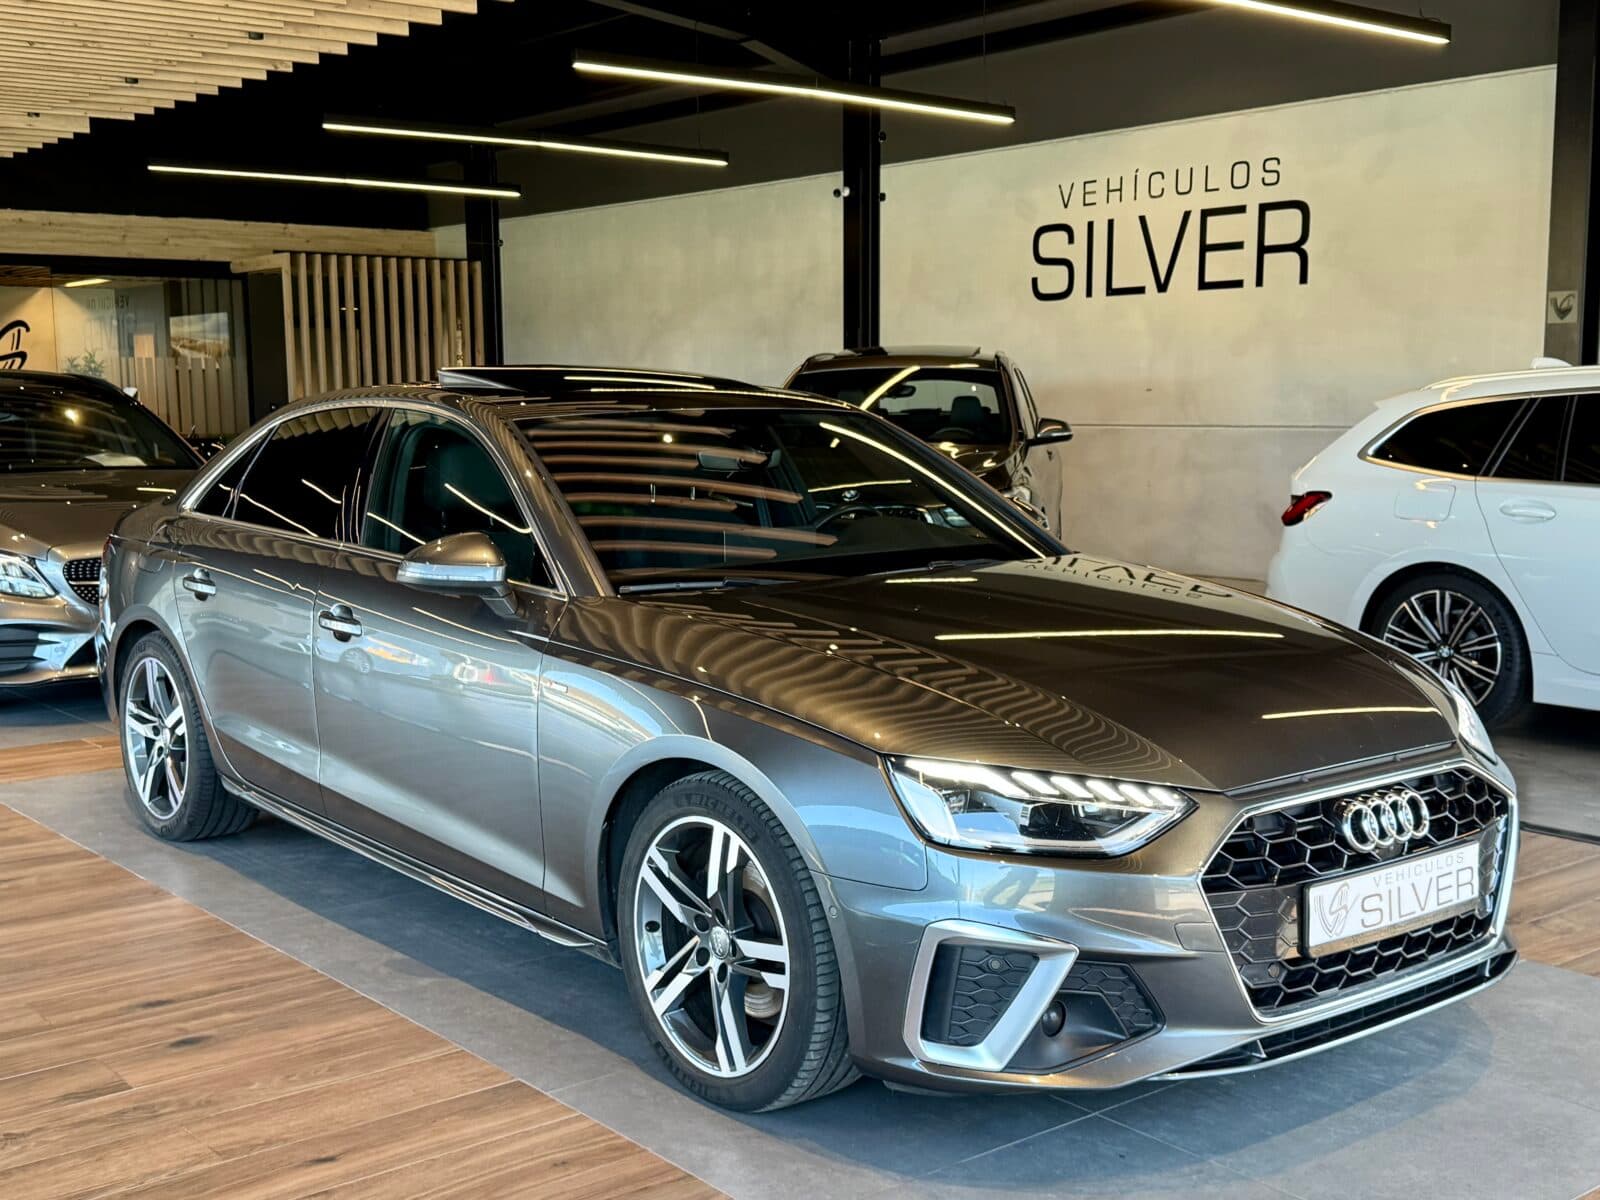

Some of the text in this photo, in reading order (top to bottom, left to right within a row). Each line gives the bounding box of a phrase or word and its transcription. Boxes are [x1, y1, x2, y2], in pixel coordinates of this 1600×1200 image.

[1058, 157, 1281, 209] VEHÍCULOS
[1031, 199, 1311, 301] SILVER
[1360, 866, 1475, 929] SILVER
